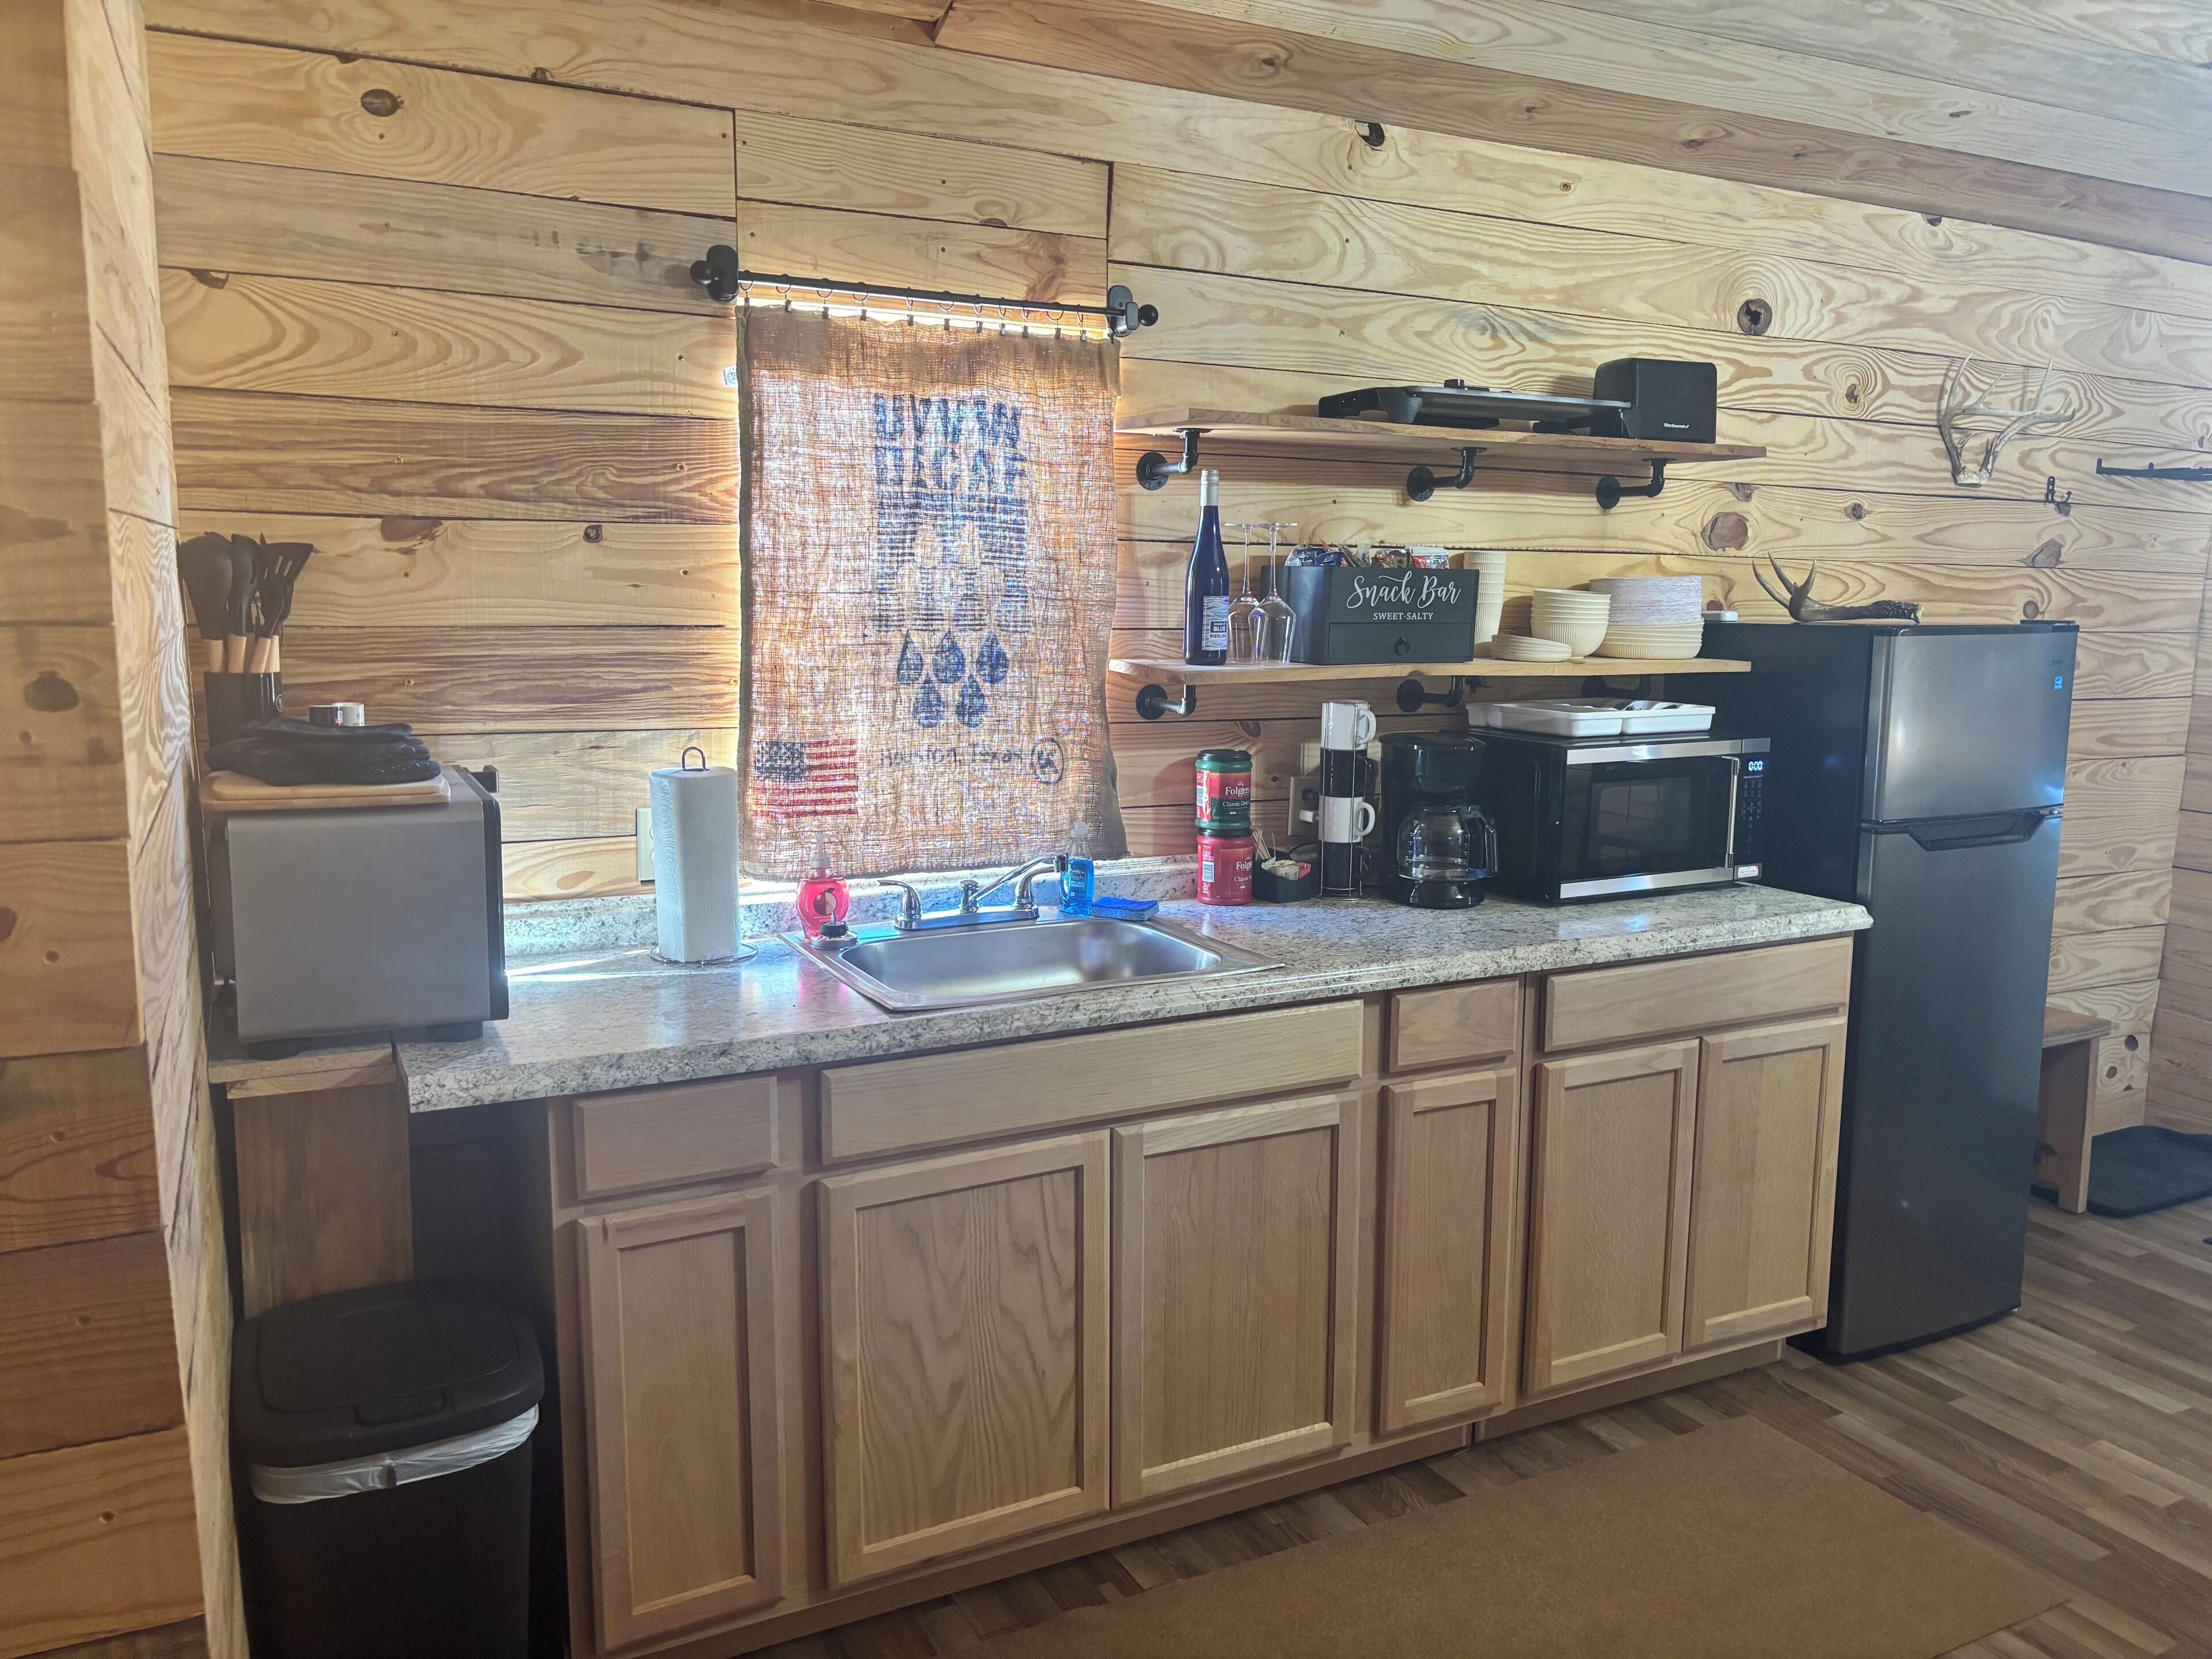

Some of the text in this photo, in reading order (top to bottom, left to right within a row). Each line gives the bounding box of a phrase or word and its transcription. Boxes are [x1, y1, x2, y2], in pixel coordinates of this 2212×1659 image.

[1346, 570, 1461, 609] Snack Bar
[1225, 786, 1250, 797] Folgers
